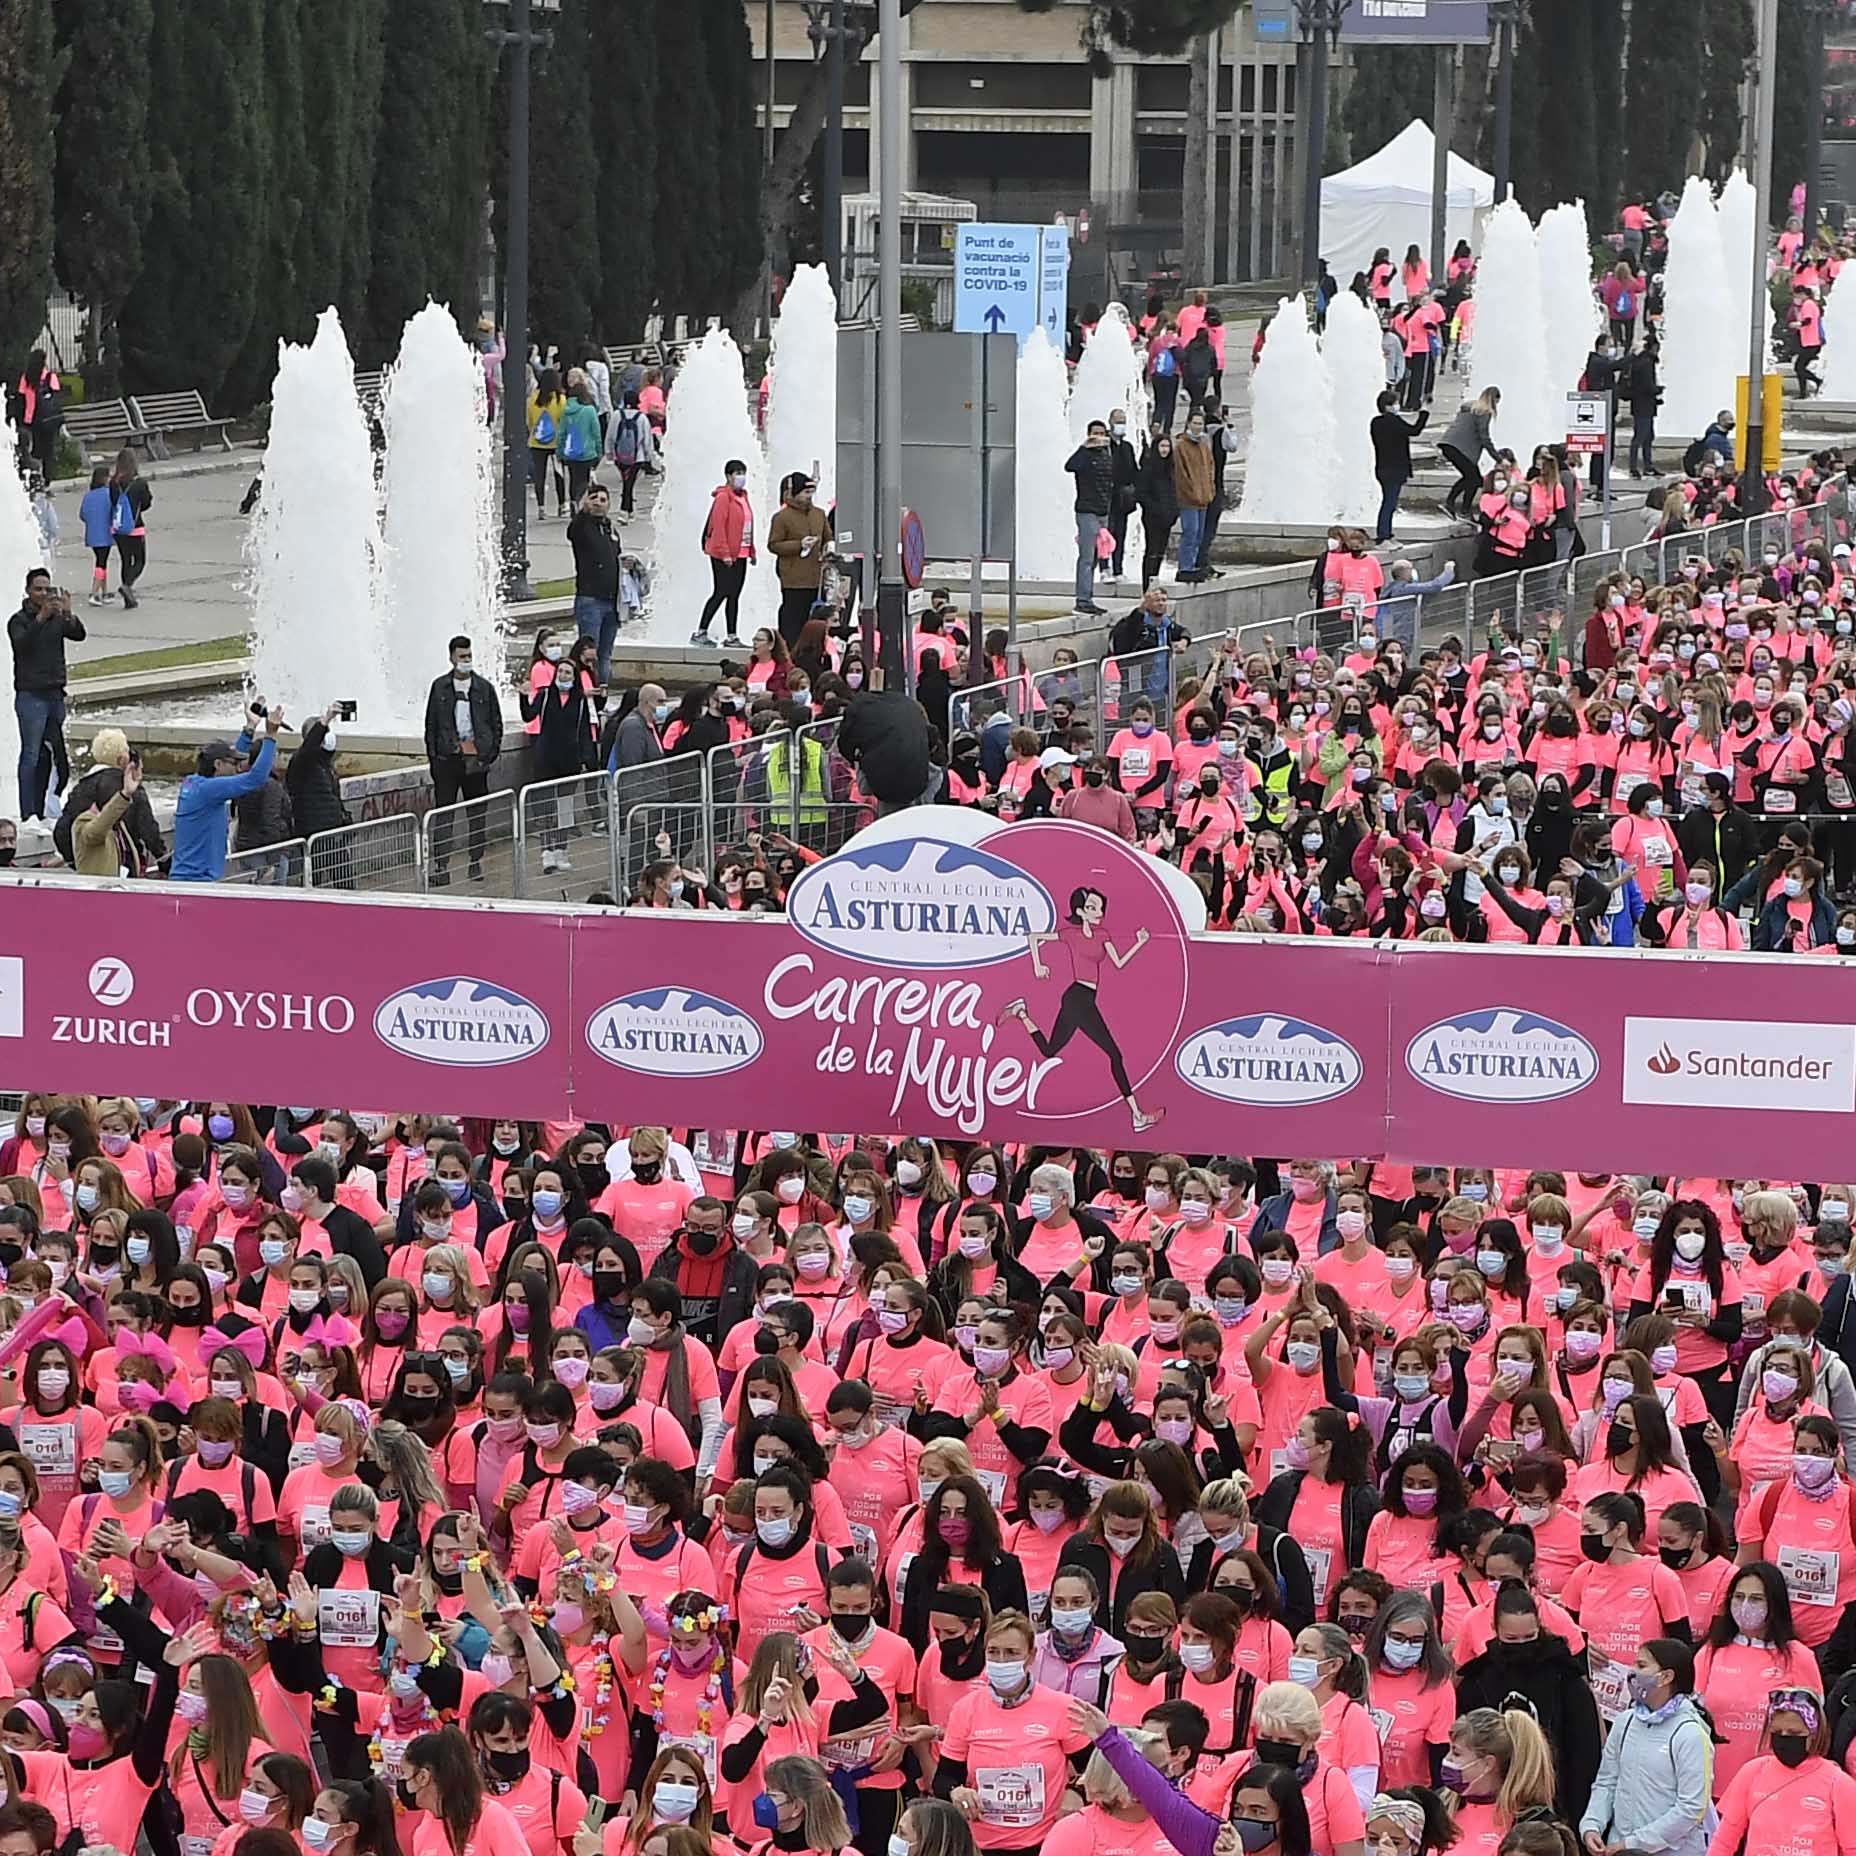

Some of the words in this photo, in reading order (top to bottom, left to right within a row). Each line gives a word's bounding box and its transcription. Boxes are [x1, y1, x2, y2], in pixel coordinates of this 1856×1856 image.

[965, 236, 994, 248] Punt
[999, 238, 1014, 248] de
[965, 252, 1030, 262] vacunació
[964, 279, 1027, 291] COVID-19
[965, 266, 1006, 276] contra
[1010, 266, 1020, 276] la
[850, 880, 933, 896] CENTRAL
[943, 884, 1025, 899] LECHERA
[810, 882, 1031, 936] ASTURIANA
[764, 954, 981, 1026] Carrera
[186, 988, 355, 1033] OYSHO
[52, 1017, 170, 1047] ZURICH
[387, 1010, 535, 1045] ASTURIANA
[600, 1019, 748, 1056] ASTURIANA
[1190, 1044, 1346, 1084] ASTURIANA
[1218, 1043, 1273, 1054] CENTRAL
[1279, 1046, 1341, 1057] LECHERA
[1421, 1040, 1583, 1080] ASTURIANA
[1686, 1050, 1833, 1082] Santander
[816, 1040, 856, 1074] de
[865, 1029, 892, 1075] la
[890, 1023, 1063, 1134] Mujer
[997, 1789, 1024, 1802] 016
